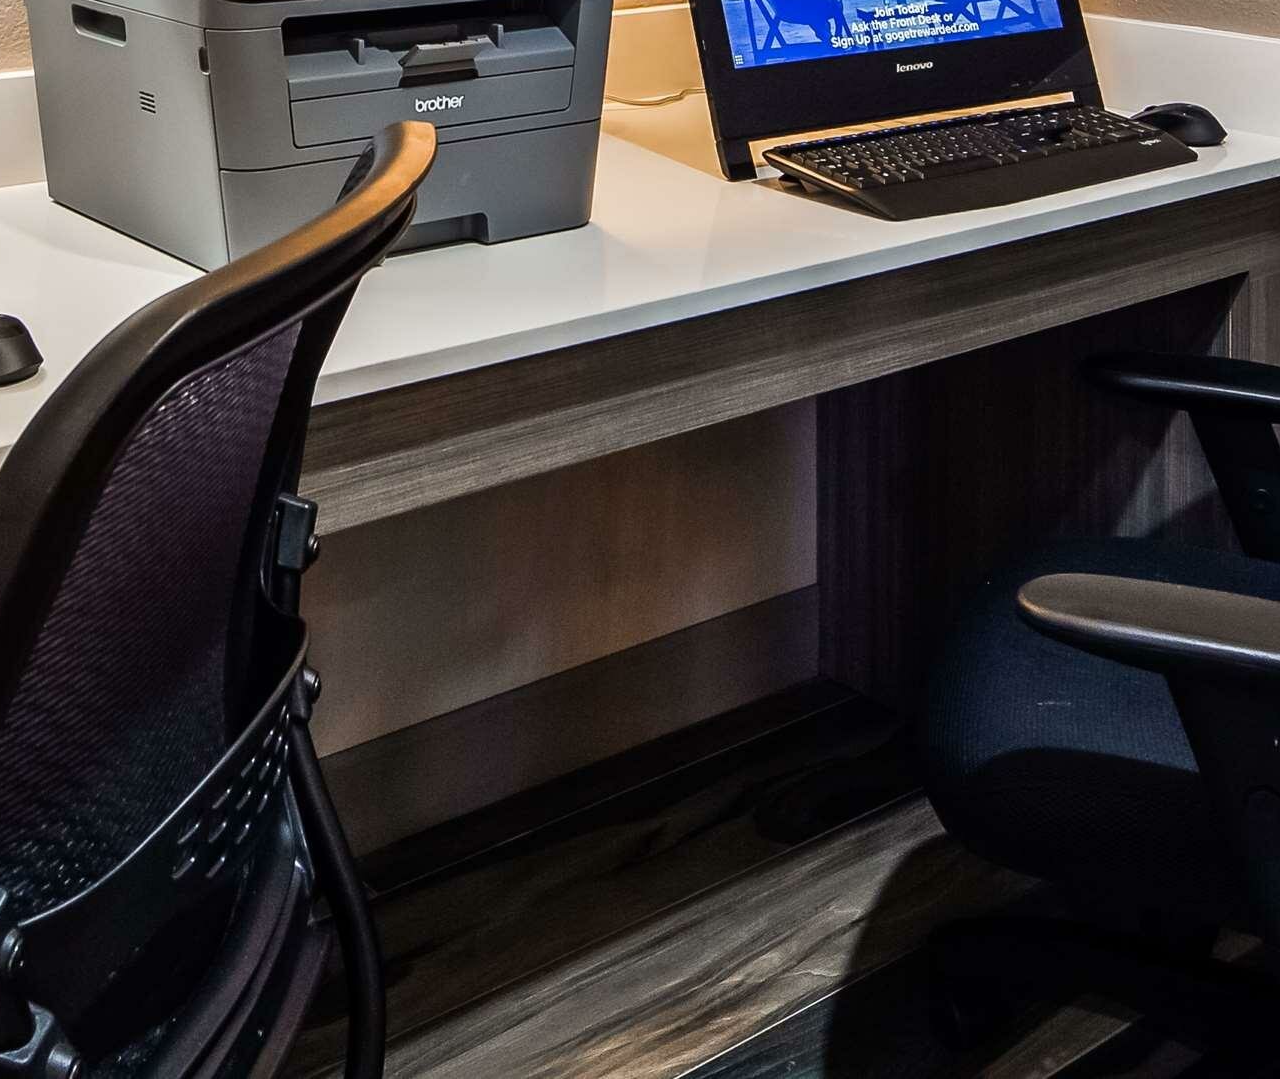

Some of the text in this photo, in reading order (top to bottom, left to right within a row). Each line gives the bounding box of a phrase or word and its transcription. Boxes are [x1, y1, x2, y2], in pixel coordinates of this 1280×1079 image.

[873, 3, 929, 19] Join Today!
[851, 13, 954, 34] Ask the Front Desk or
[830, 21, 980, 49] Sign Up at gogetrewarded.com
[896, 60, 934, 73] lenovo
[414, 94, 465, 113] brother
